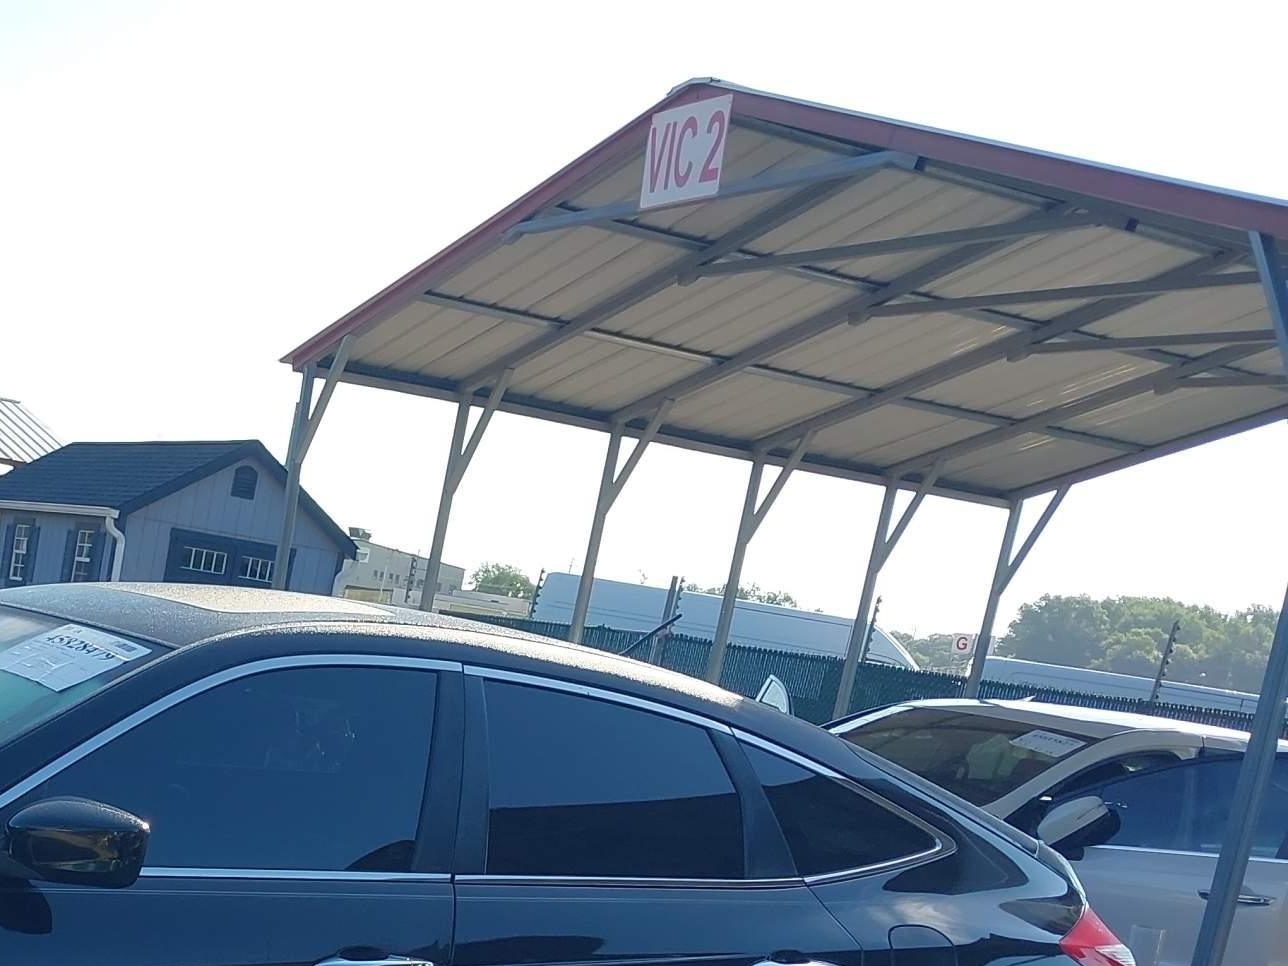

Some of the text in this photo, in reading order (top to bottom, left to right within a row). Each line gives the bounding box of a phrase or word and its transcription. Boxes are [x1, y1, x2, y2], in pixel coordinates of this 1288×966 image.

[649, 110, 725, 193] VIC 2
[956, 636, 968, 651] G
